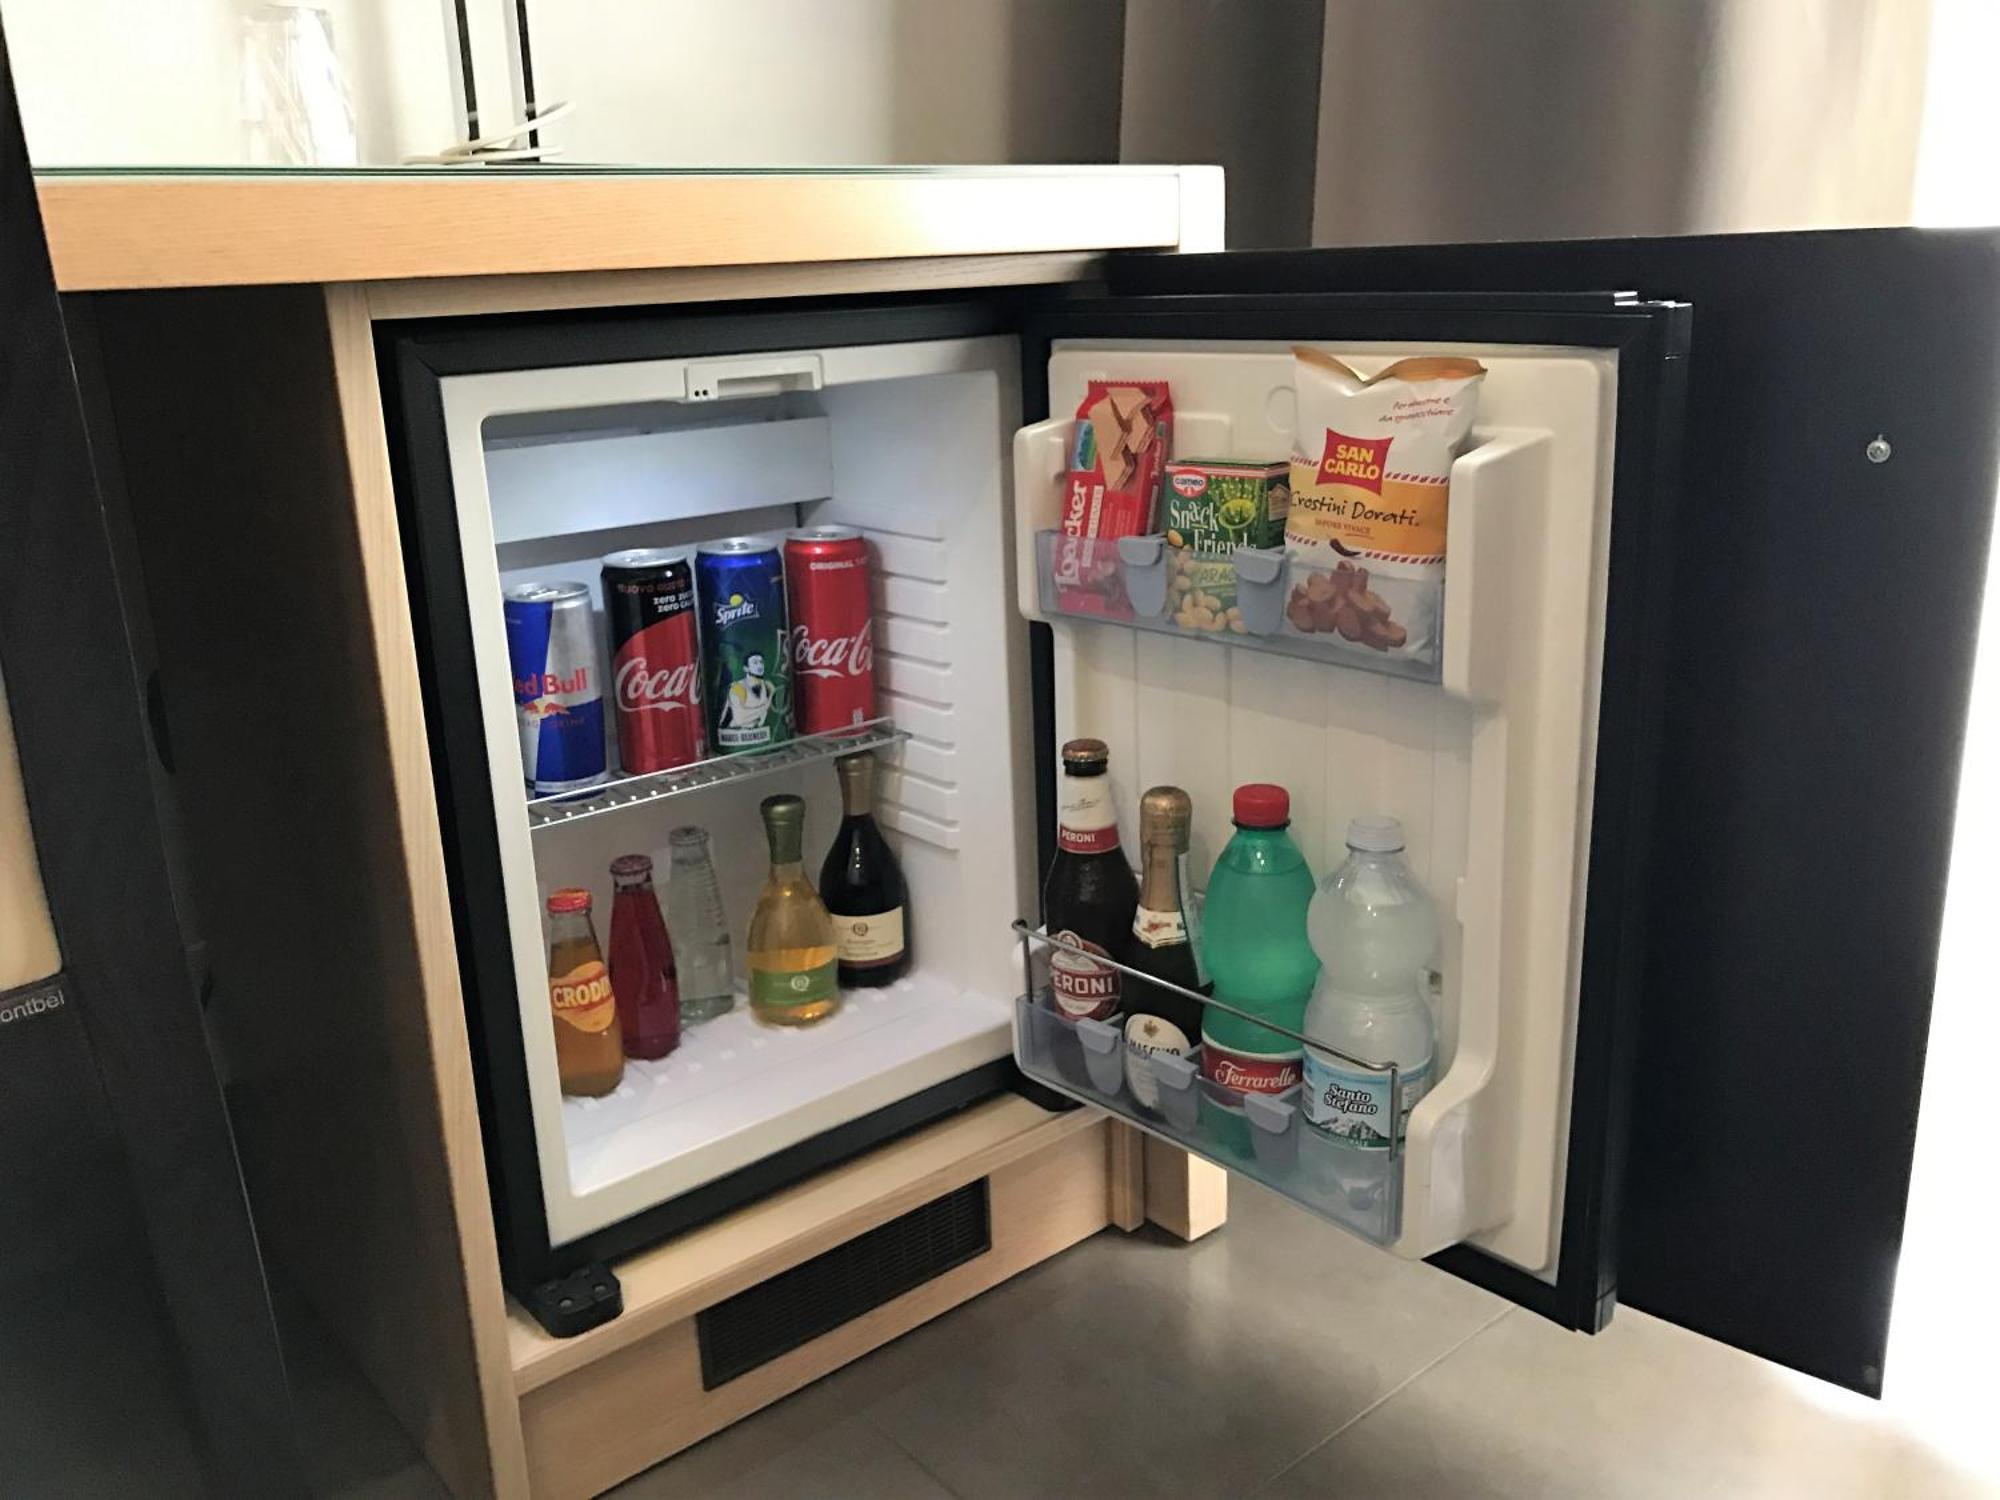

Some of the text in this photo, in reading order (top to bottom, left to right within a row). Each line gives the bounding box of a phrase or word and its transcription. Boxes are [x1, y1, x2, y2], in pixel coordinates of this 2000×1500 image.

[1336, 444, 1375, 464] SAN
[1324, 458, 1380, 481] CARLO
[1290, 489, 1348, 516] Crostini
[1169, 498, 1220, 532] Snack
[809, 560, 855, 571] ORIGINAL
[652, 595, 676, 605] zero
[657, 603, 680, 613] zero
[715, 601, 754, 626] Sprite
[513, 667, 588, 696] ed Bull
[1062, 829, 1096, 843] PERONI
[1051, 969, 1114, 995] ERONI
[1214, 1060, 1297, 1090] Ferrarelle
[1323, 1092, 1379, 1115] Stefano
[1327, 1082, 1373, 1103] Santo
